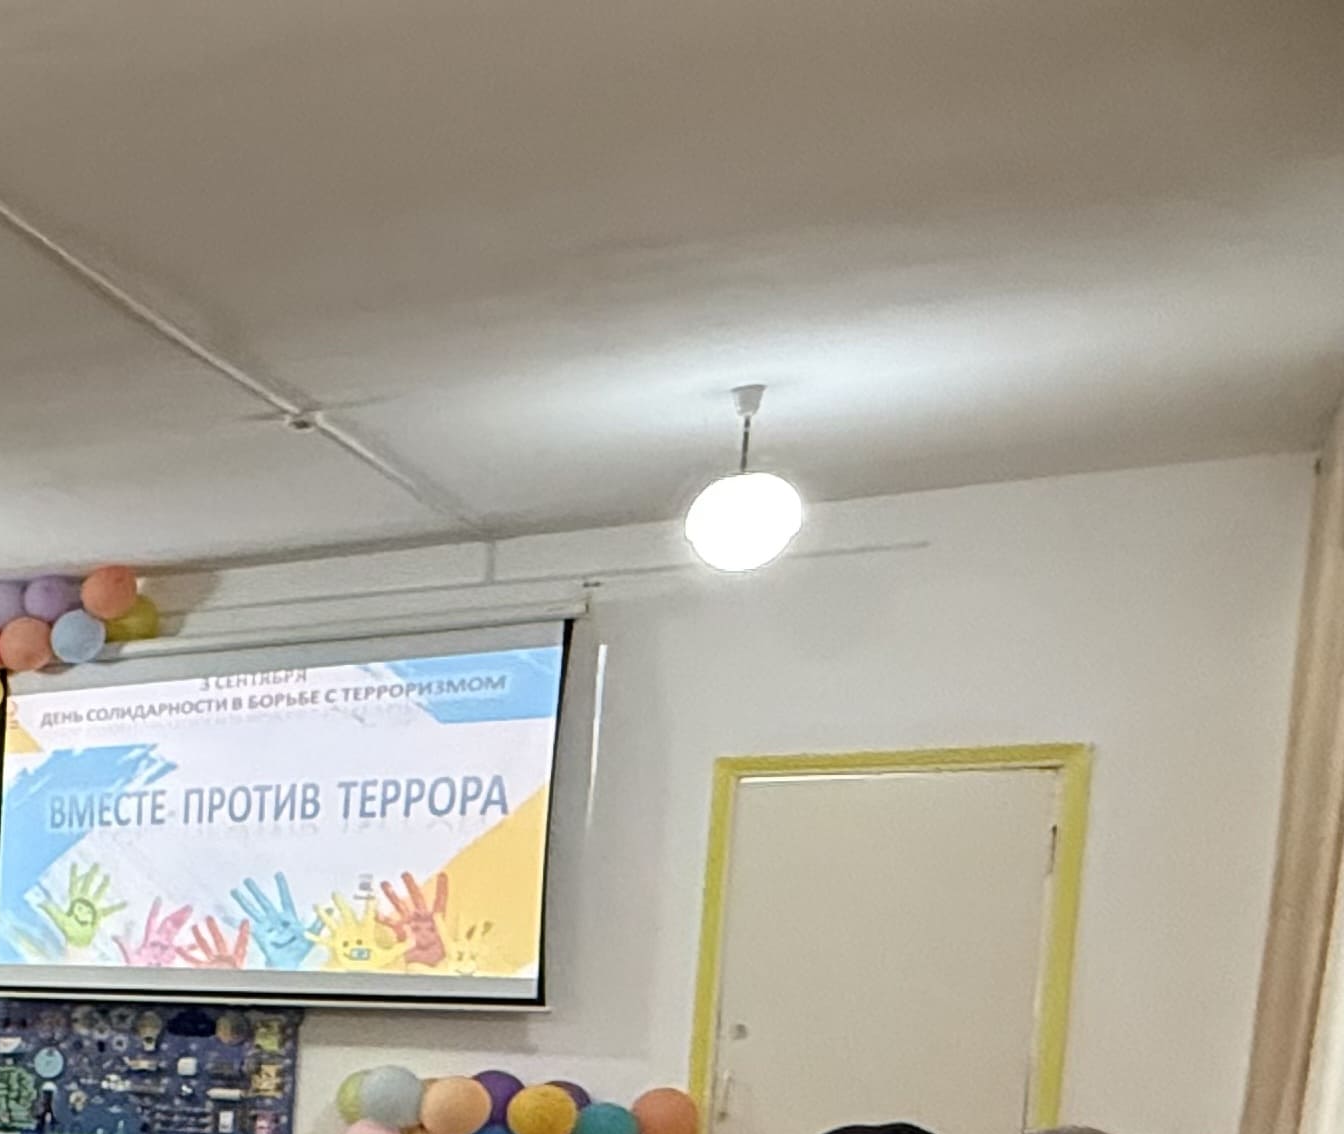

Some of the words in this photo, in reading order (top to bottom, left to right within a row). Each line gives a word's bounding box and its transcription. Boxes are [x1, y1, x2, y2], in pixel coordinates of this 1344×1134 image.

[40, 709, 83, 729] ДЕНЬ
[86, 698, 228, 723] СОЛИДАРНОСТИ
[231, 696, 243, 711] В
[248, 690, 320, 709] БОРЬБЕ
[324, 688, 337, 703] С
[341, 675, 507, 702] ТЕРРОРИЗМОМ
[215, 669, 307, 690] СЕНТЯБРЯ
[49, 789, 167, 829] ВМЕСТЕ
[183, 783, 321, 825] ПРОТИВ
[336, 775, 509, 821] ТЕРРОРА
